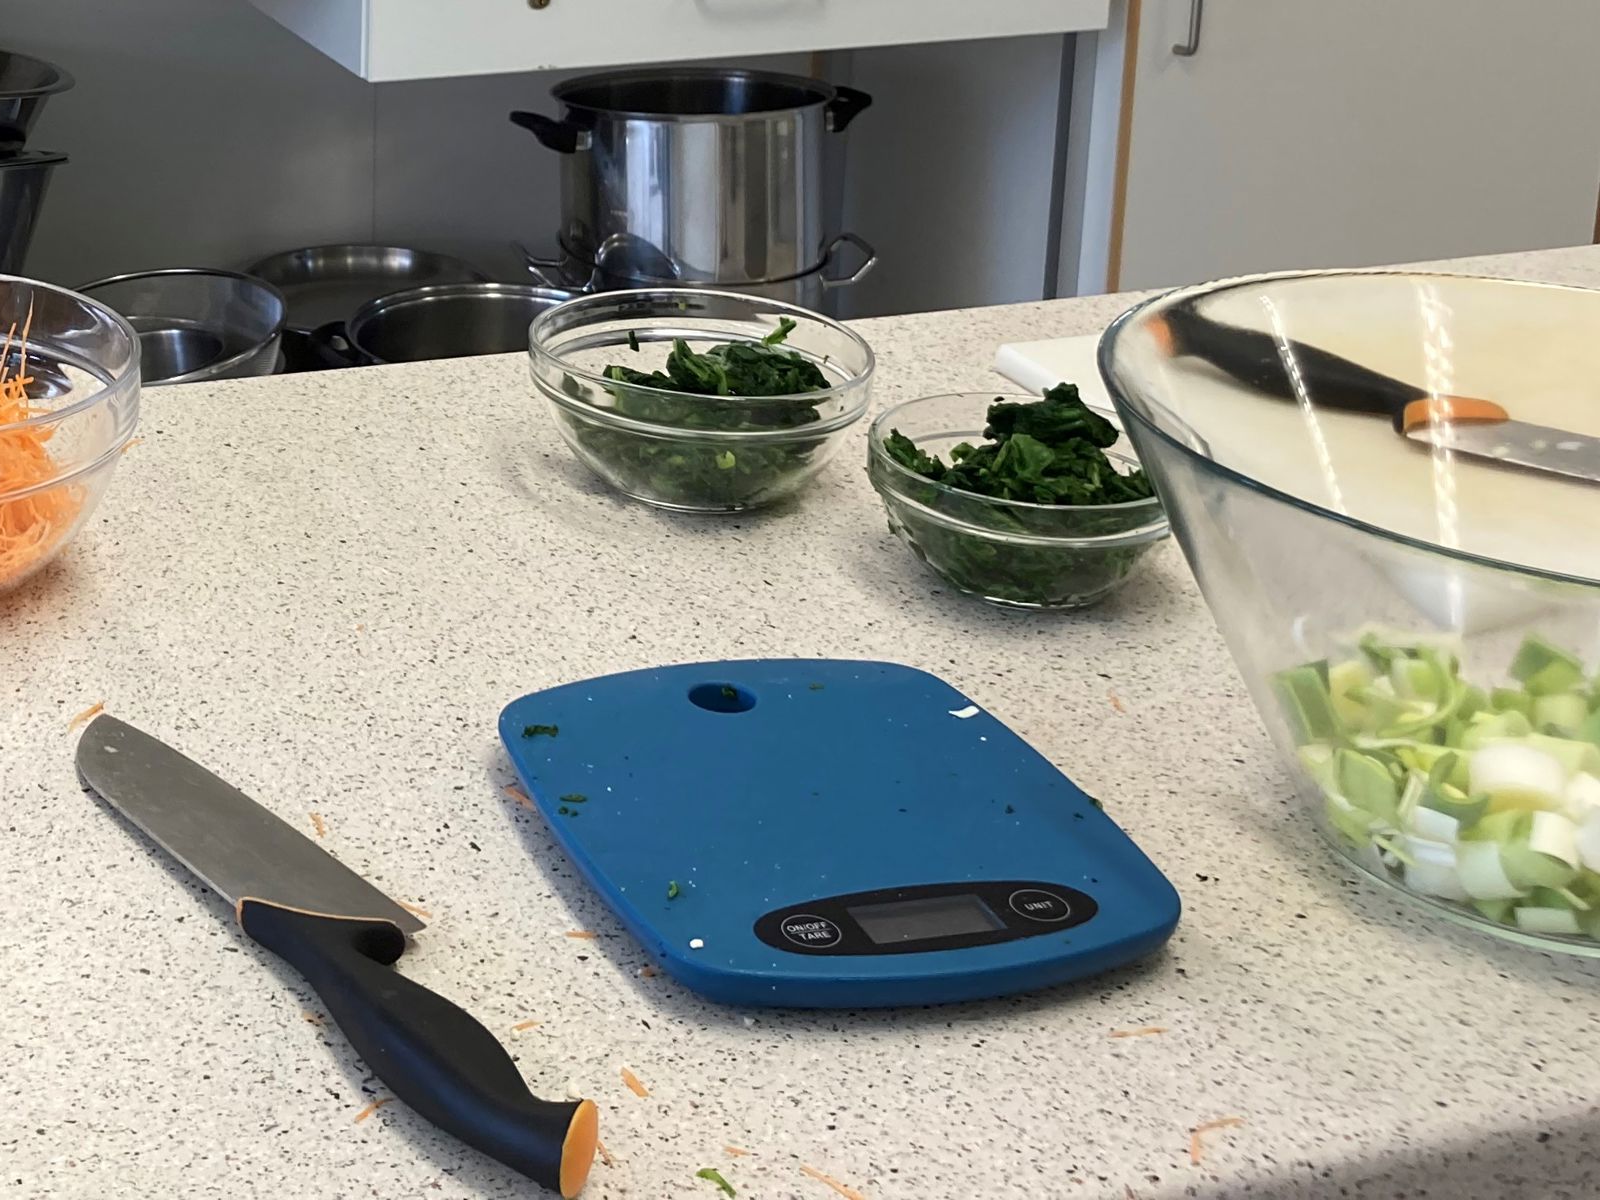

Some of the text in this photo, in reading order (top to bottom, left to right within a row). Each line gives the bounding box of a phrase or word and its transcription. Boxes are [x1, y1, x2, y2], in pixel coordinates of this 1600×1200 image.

[1024, 901, 1053, 911] UNIT
[786, 921, 827, 932] ON/OFF
[798, 931, 832, 940] TARE
